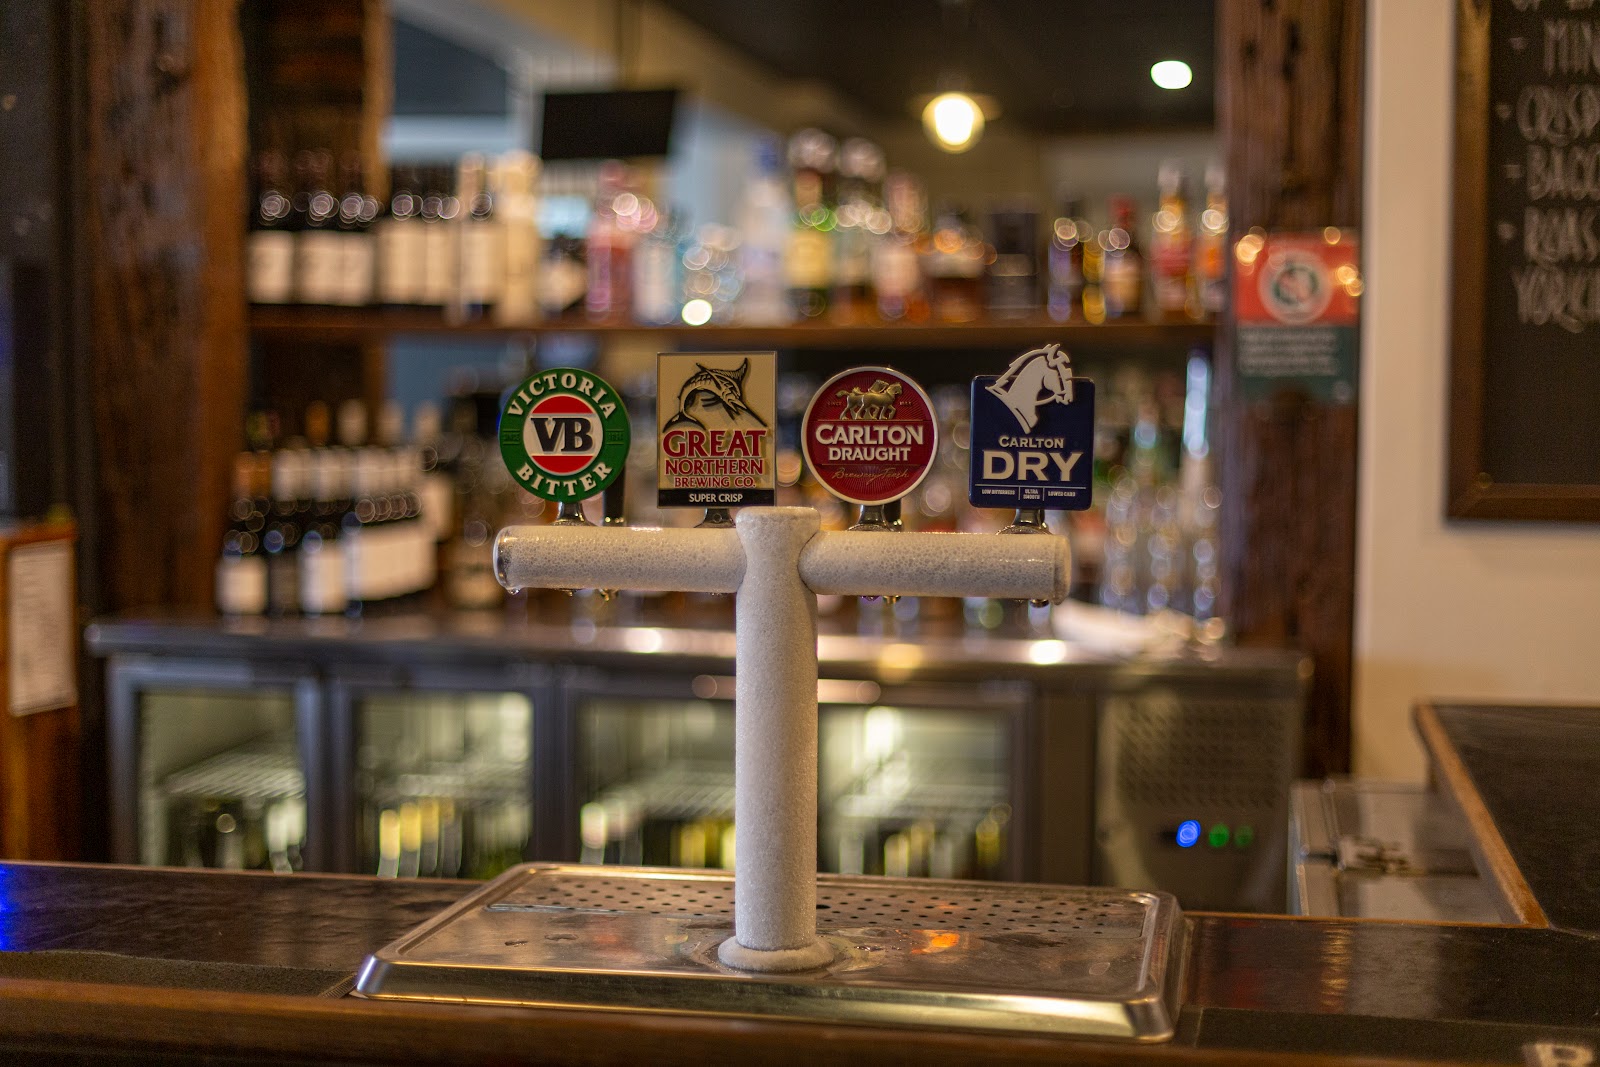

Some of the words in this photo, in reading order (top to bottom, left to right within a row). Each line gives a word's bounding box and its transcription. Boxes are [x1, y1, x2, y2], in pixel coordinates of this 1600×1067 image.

[507, 373, 618, 419] VICTORIA
[530, 418, 594, 452] VB
[663, 430, 767, 457] GREAT
[815, 424, 924, 445] CARLTON
[998, 436, 1065, 449] CARLTON
[828, 447, 911, 462] DRAUGHT
[665, 459, 764, 475] NORTHERN
[982, 451, 1084, 482] DRY
[516, 461, 613, 496] BITTER
[674, 476, 730, 488] BREWING
[734, 476, 756, 488] CO.
[689, 493, 716, 502] SUPER
[718, 494, 743, 503] CRISP
